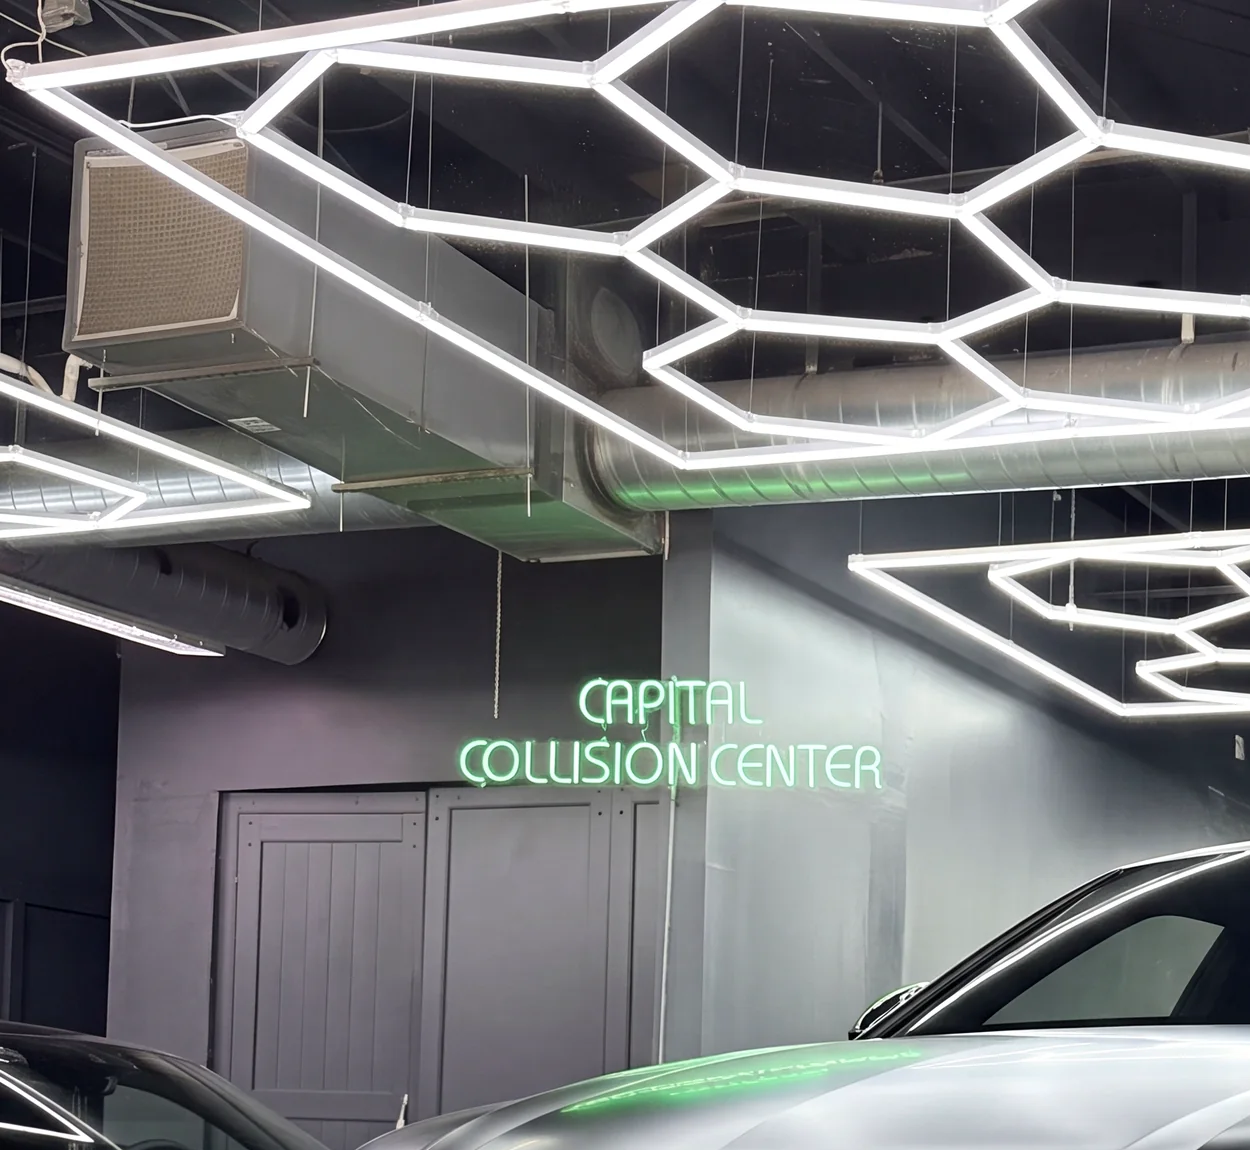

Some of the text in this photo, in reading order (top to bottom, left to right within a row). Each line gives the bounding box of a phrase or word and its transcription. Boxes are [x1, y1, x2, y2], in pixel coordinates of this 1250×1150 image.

[578, 679, 764, 725] CAPITAL
[458, 739, 883, 789] COLLISION CENTER
